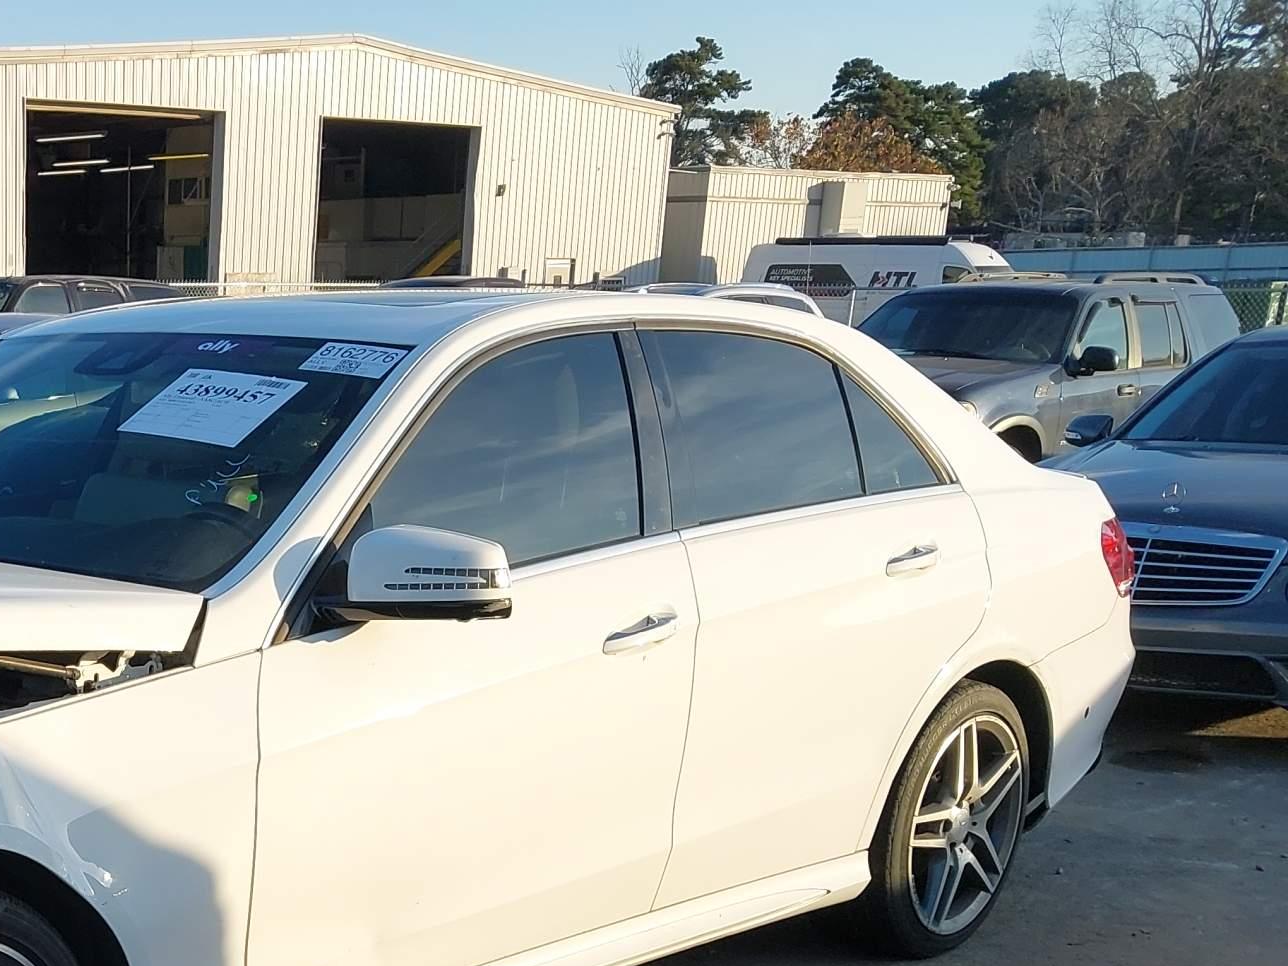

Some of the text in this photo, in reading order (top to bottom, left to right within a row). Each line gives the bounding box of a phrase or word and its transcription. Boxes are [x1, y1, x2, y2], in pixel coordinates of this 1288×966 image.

[197, 339, 241, 354] ally
[319, 345, 399, 364] 8162776
[176, 382, 277, 405] 43899457
